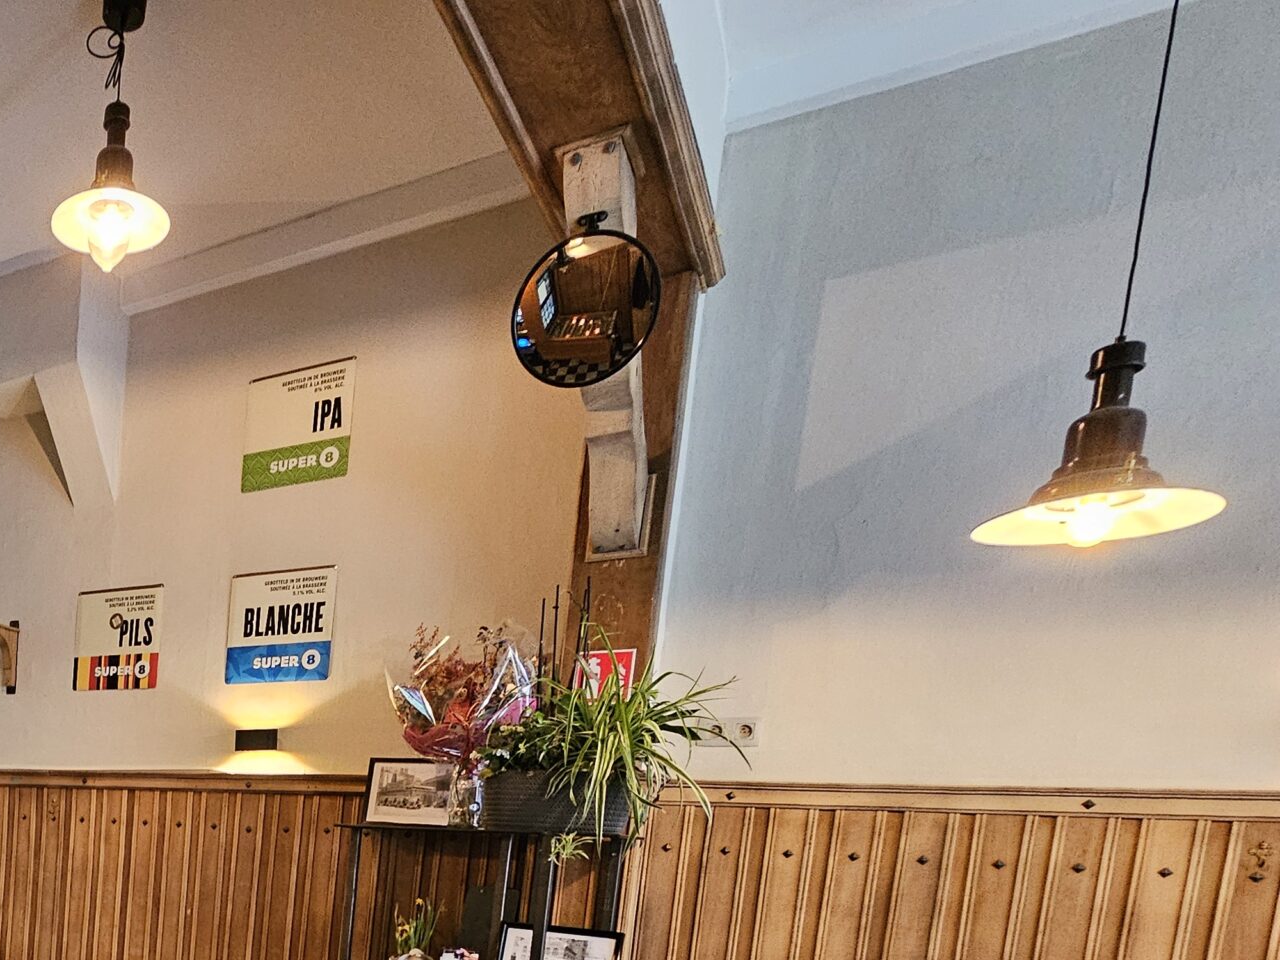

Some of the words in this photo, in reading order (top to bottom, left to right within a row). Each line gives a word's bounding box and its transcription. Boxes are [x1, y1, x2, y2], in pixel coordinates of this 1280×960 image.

[312, 396, 342, 433] IPA
[269, 454, 317, 474] SUPER
[118, 617, 154, 647] PILS
[243, 601, 326, 638] BLANCHE
[94, 666, 132, 677] SUPER
[252, 655, 299, 669] SUPER
